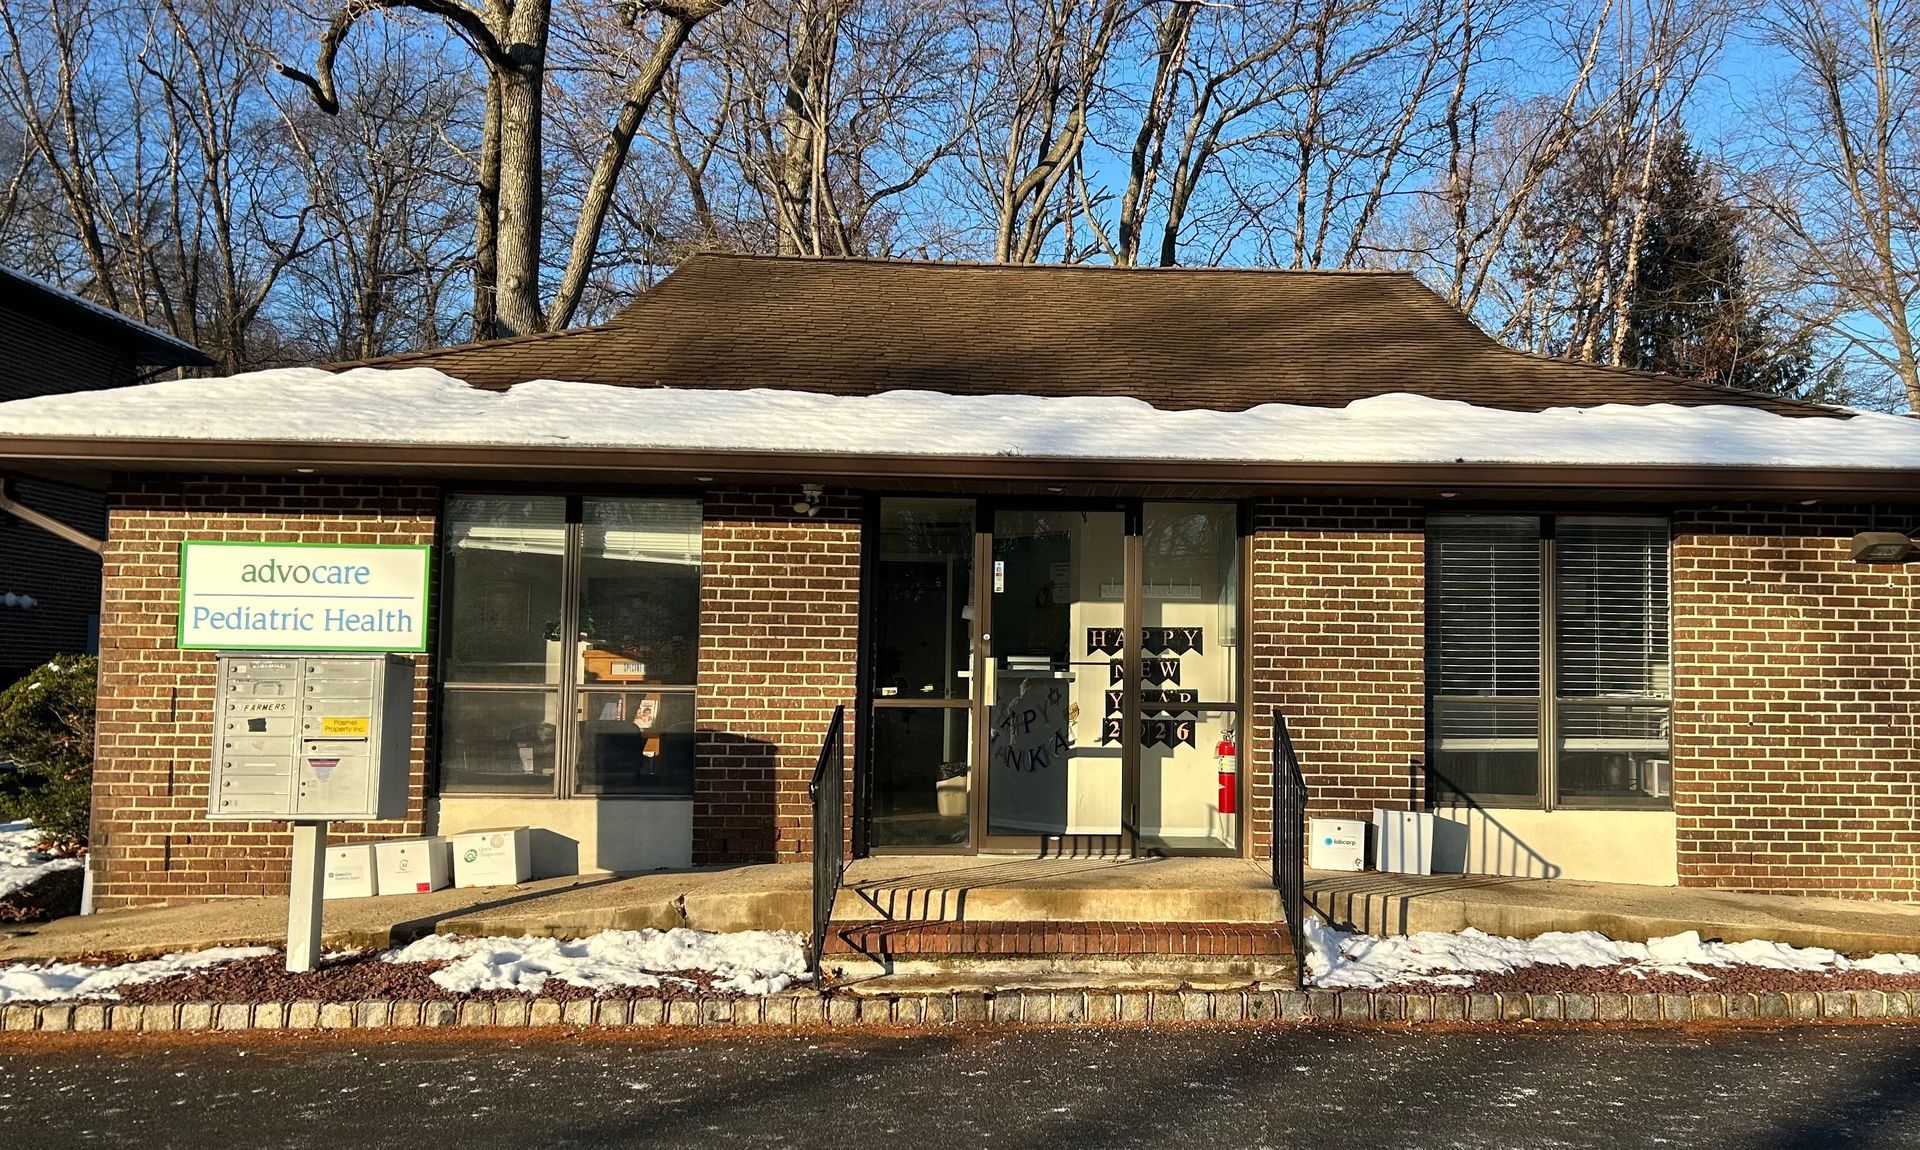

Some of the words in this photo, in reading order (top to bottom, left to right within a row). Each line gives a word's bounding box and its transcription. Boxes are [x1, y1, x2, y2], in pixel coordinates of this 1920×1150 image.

[241, 559, 370, 584] advocare
[193, 606, 314, 631] Pediatric
[324, 608, 413, 632] Health
[243, 703, 287, 712] FARMERS
[325, 725, 353, 733] Property
